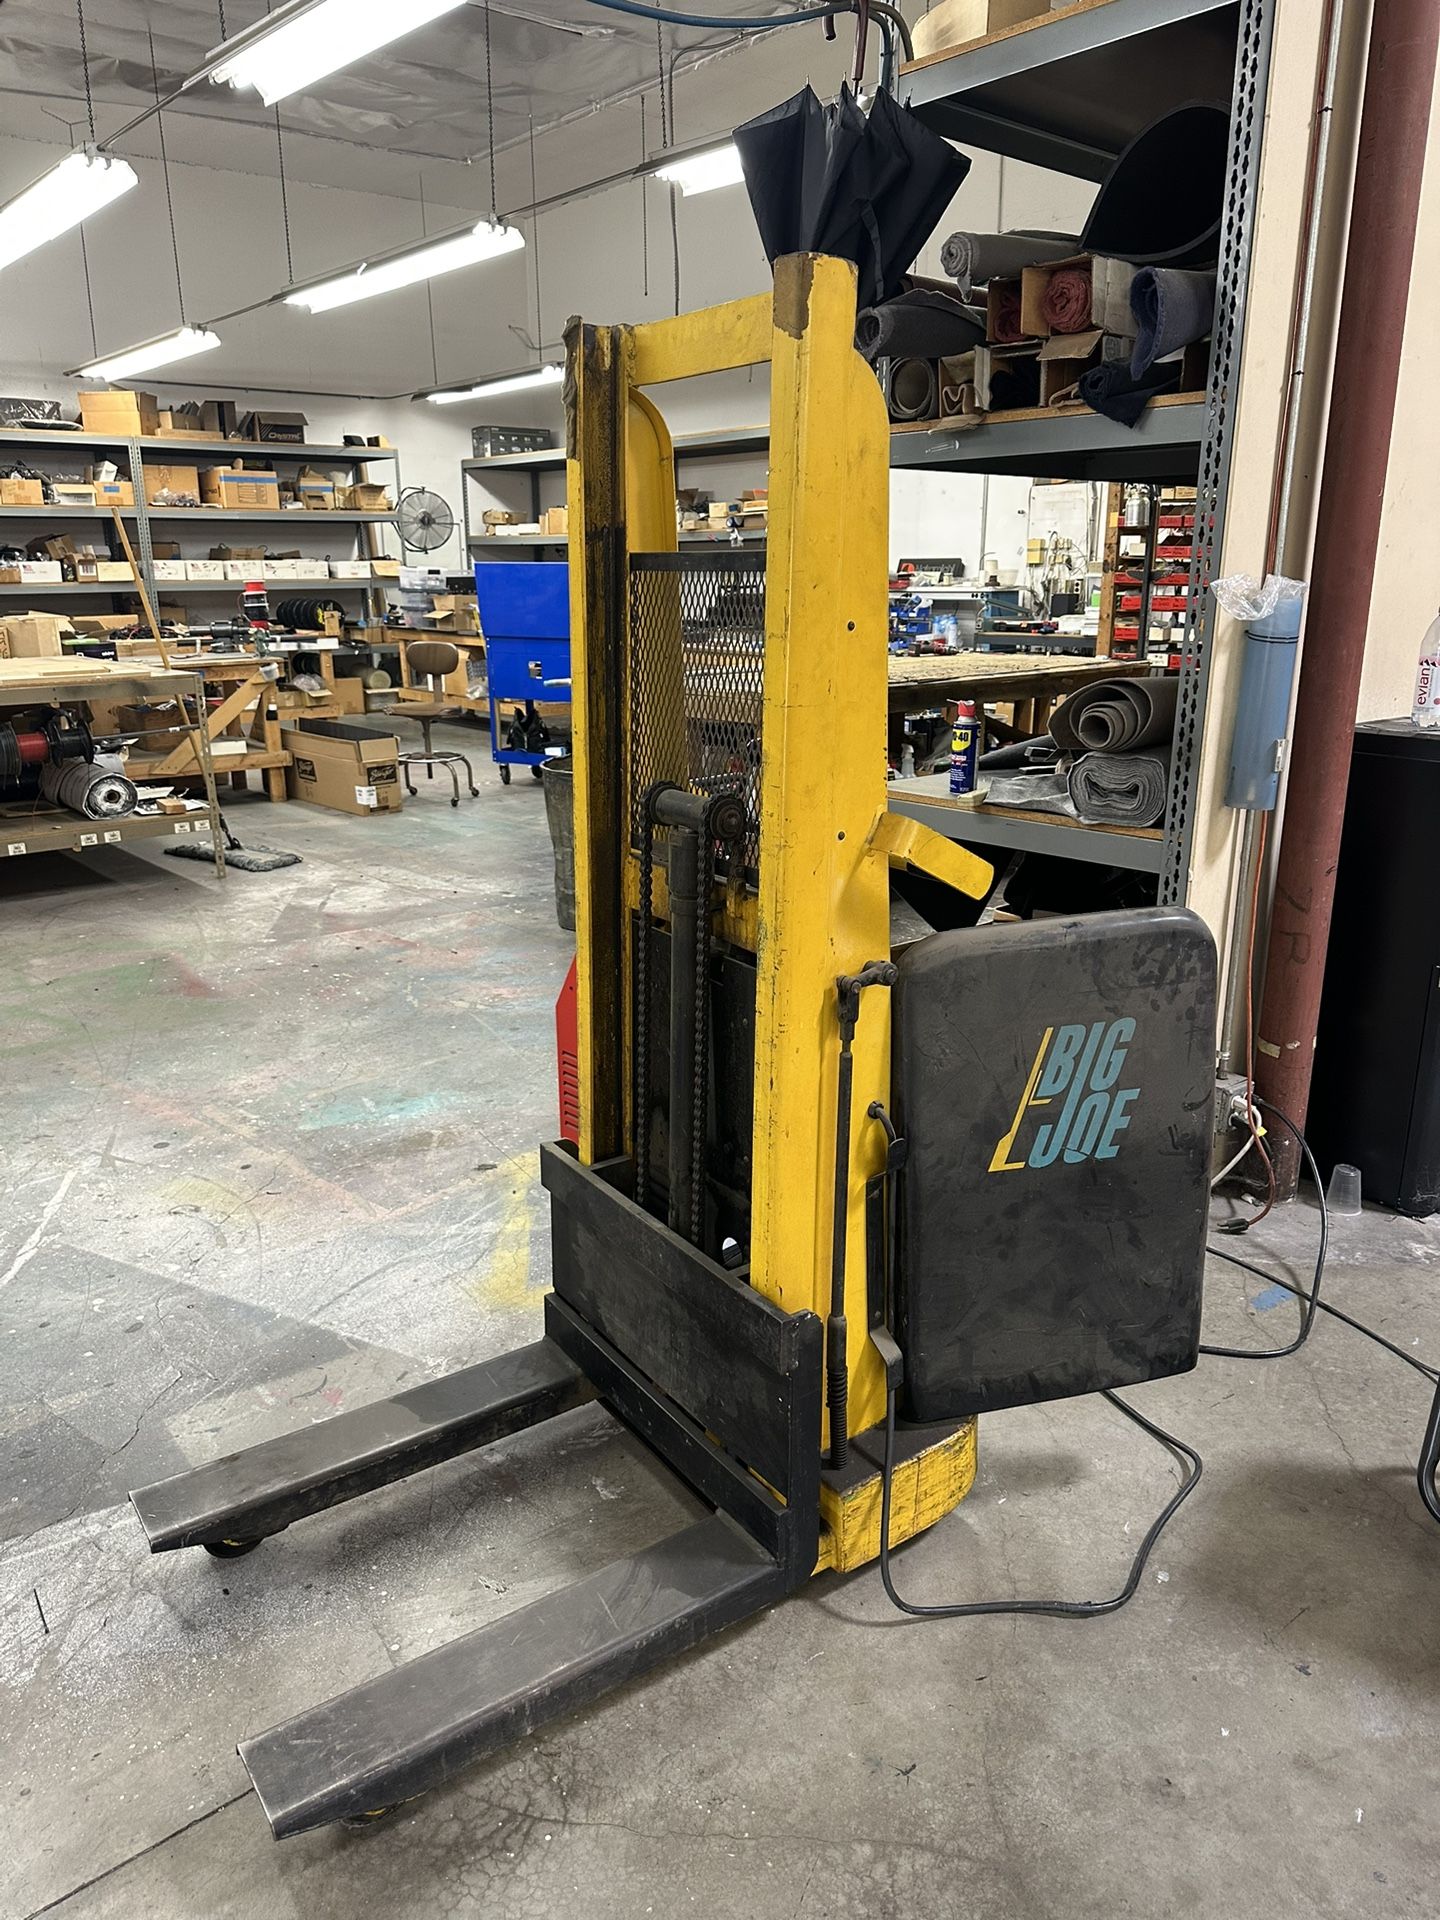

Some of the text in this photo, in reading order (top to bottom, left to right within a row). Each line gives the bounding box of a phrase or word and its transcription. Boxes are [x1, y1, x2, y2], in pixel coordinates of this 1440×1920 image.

[1417, 667, 1431, 705] evian
[1036, 1017, 1137, 1098] BIG
[1028, 1087, 1141, 1169] JOE
